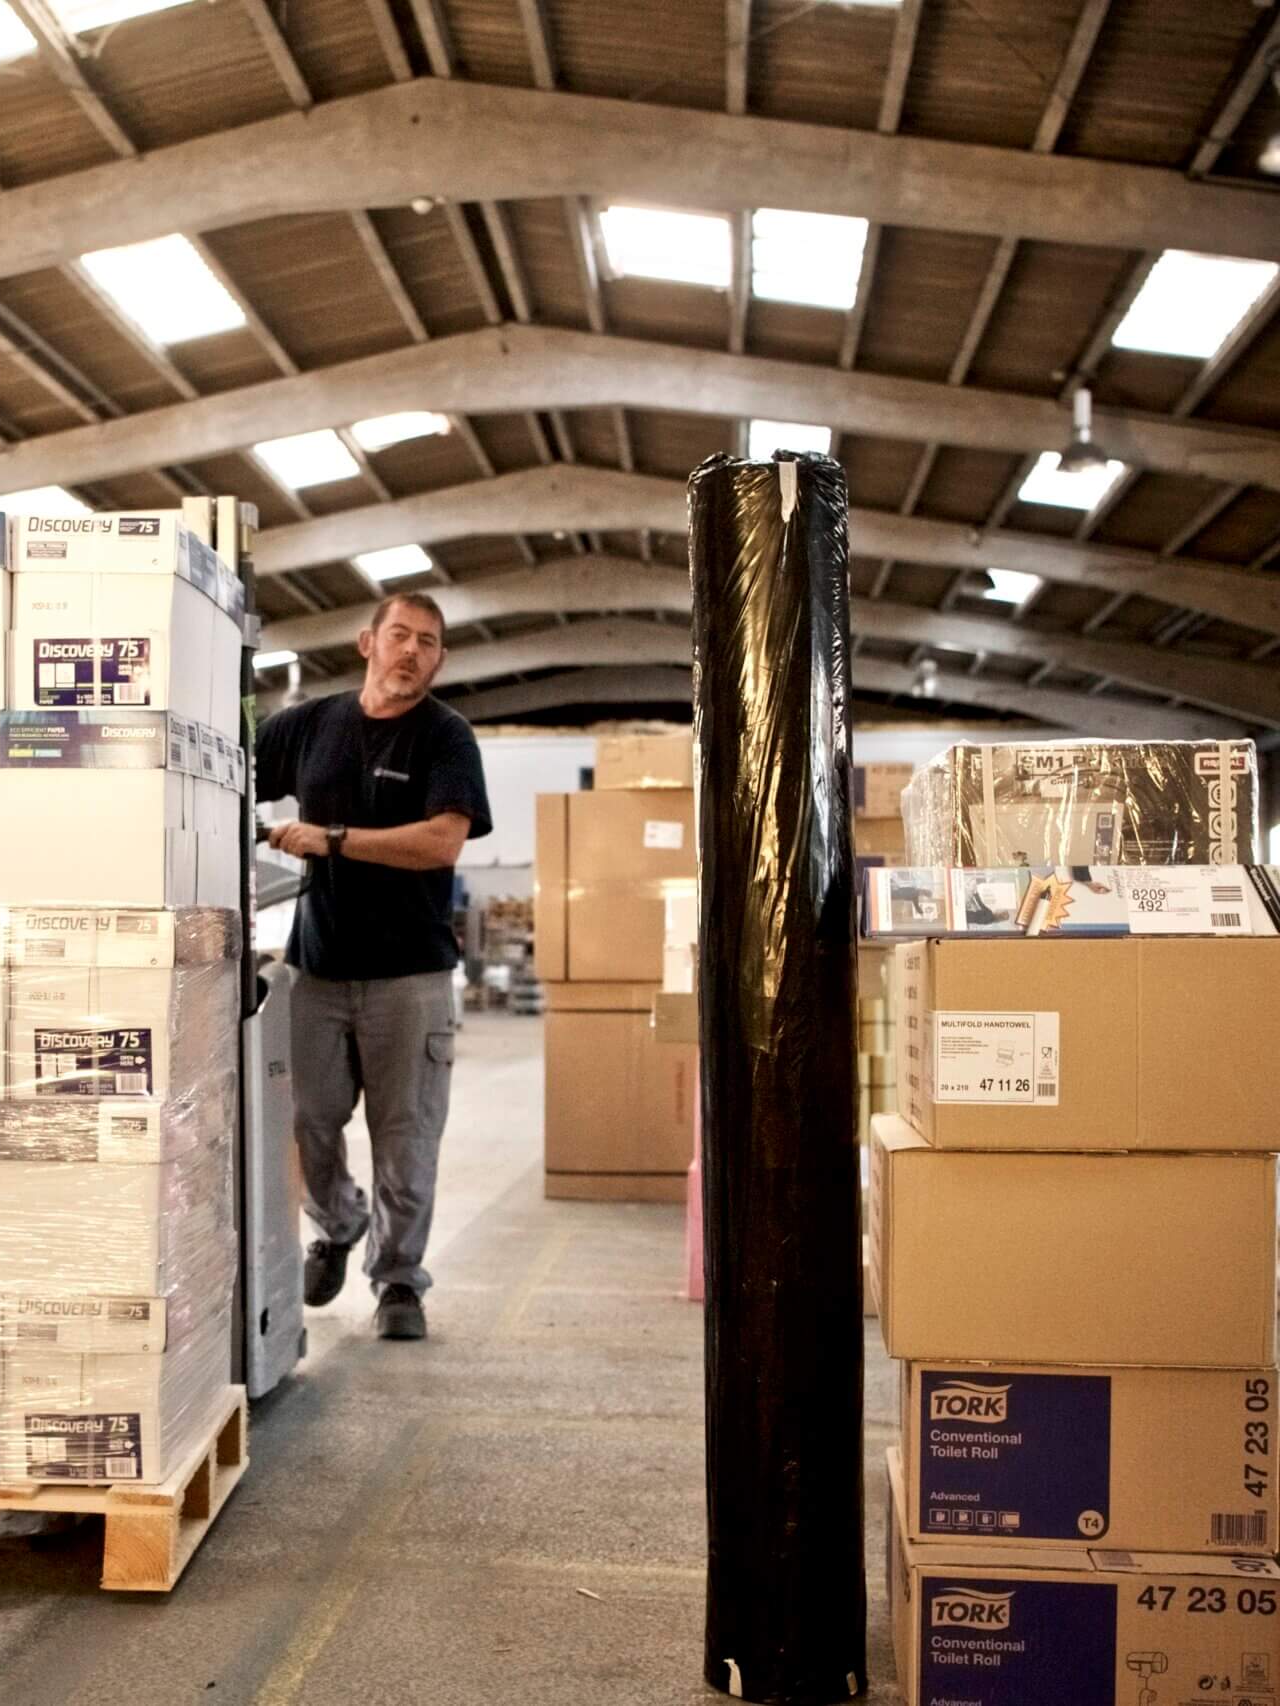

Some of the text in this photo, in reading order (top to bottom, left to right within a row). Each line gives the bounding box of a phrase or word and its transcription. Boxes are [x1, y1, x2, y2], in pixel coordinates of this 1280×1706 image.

[138, 522, 153, 533] 75
[118, 640, 139, 657] 75
[101, 726, 156, 738] DISCOVERY
[1132, 888, 1166, 901] 8209
[1138, 900, 1163, 912] 492
[137, 919, 152, 931] 75
[119, 1031, 140, 1048] 75
[979, 1078, 1030, 1092] 47 11 26
[128, 1305, 143, 1318] 75
[933, 1394, 1002, 1417] TORK
[30, 1416, 129, 1433] DISCOVERY 75
[930, 1429, 1022, 1445] Conventional
[1245, 1378, 1270, 1498] 47 23 05
[930, 1445, 999, 1460] Toilet Roll
[930, 1491, 980, 1502] Advanced
[1083, 1517, 1099, 1530] T4
[1136, 1585, 1278, 1616] 47 23 05
[935, 1601, 1006, 1624] TORK
[931, 1636, 1026, 1652] Conventional
[931, 1652, 1001, 1666] Toilet Roll
[930, 1697, 982, 1706] Advanced
